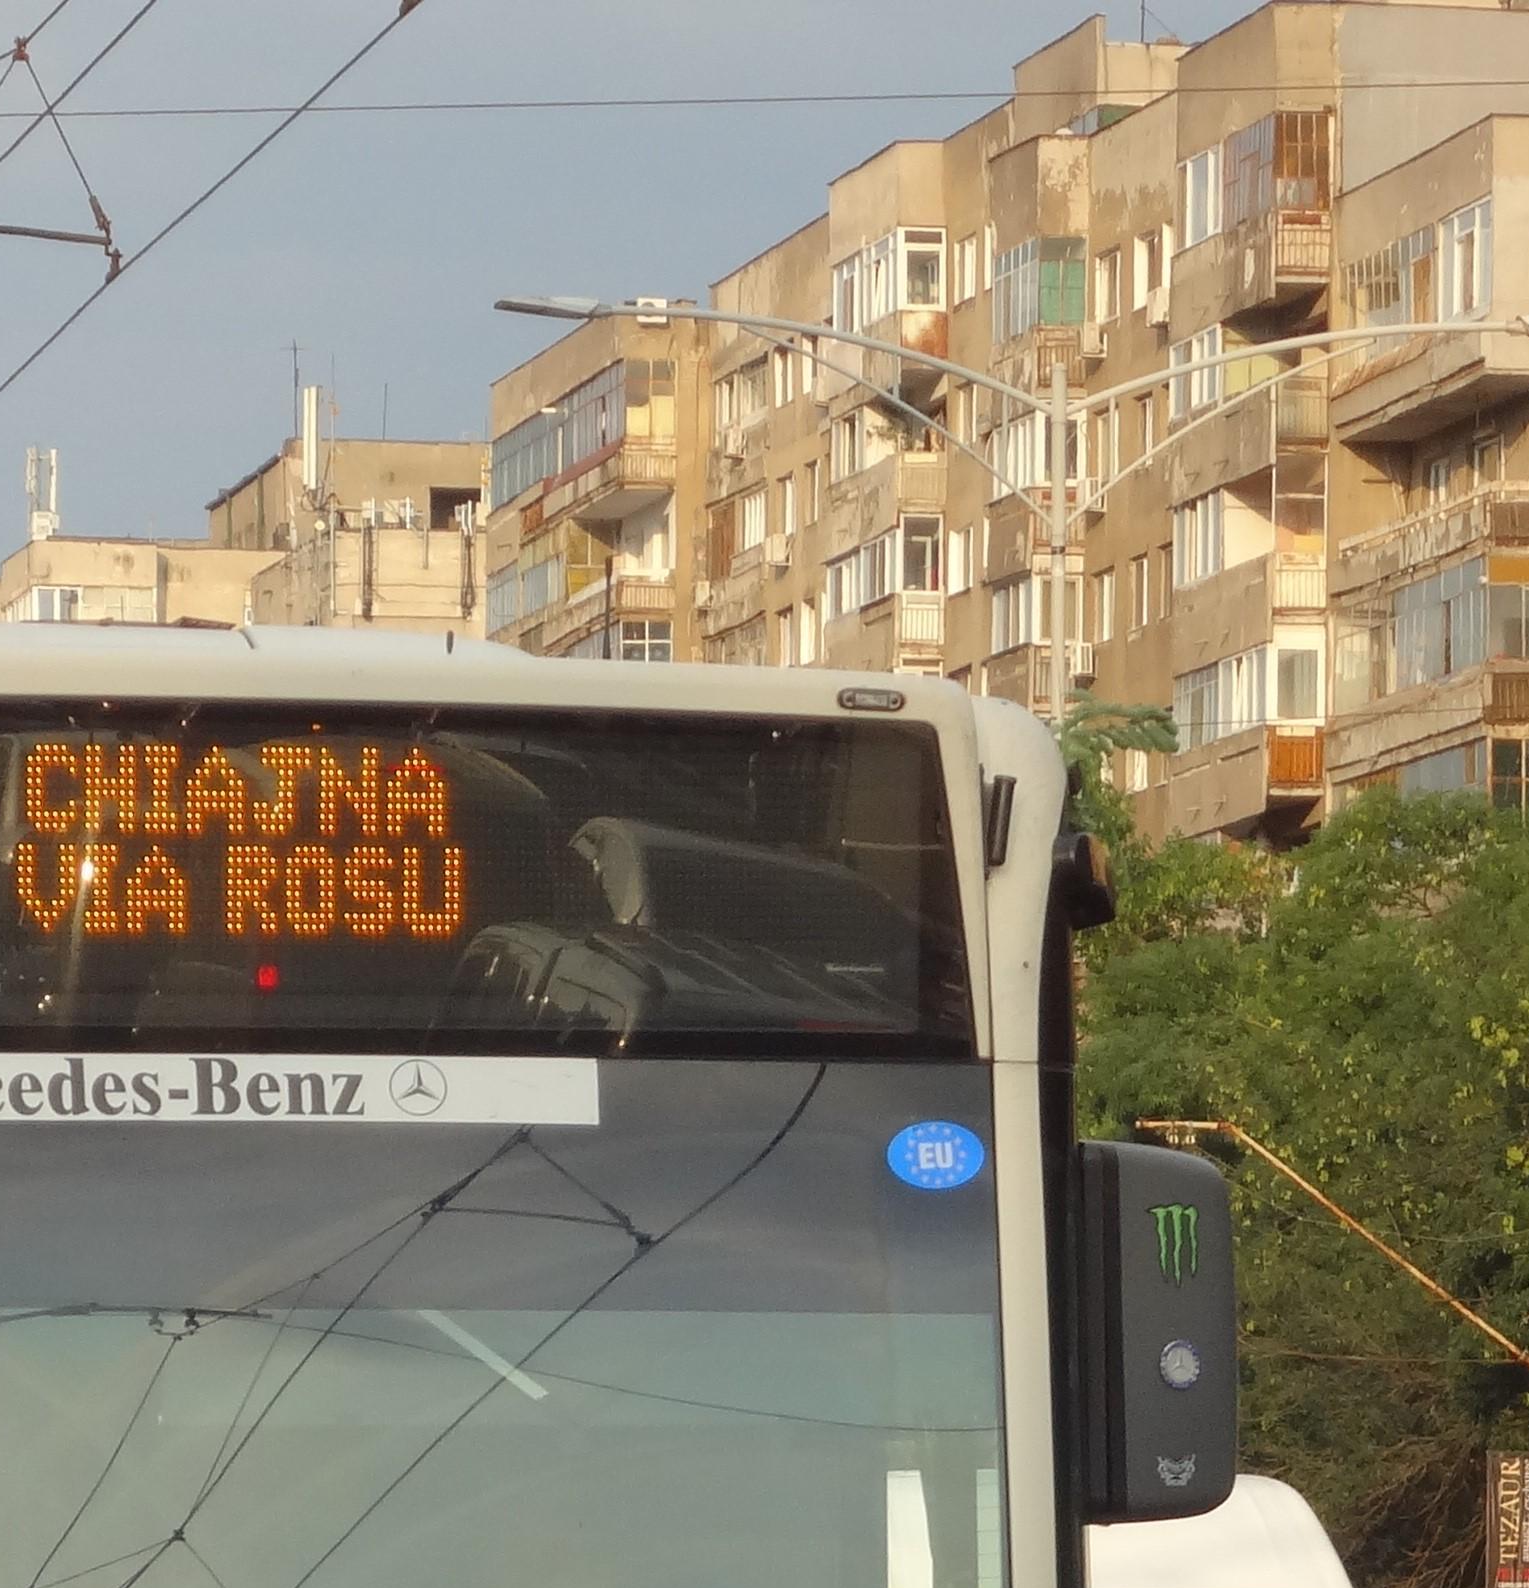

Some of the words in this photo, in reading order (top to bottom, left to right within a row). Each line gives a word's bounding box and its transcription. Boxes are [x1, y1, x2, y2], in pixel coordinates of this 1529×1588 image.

[26, 742, 446, 832] CHIAJNA
[16, 842, 186, 932] VIA
[226, 844, 462, 933] ROSU
[918, 1141, 954, 1169] EU
[1499, 1457, 1521, 1564] TEZAUR
